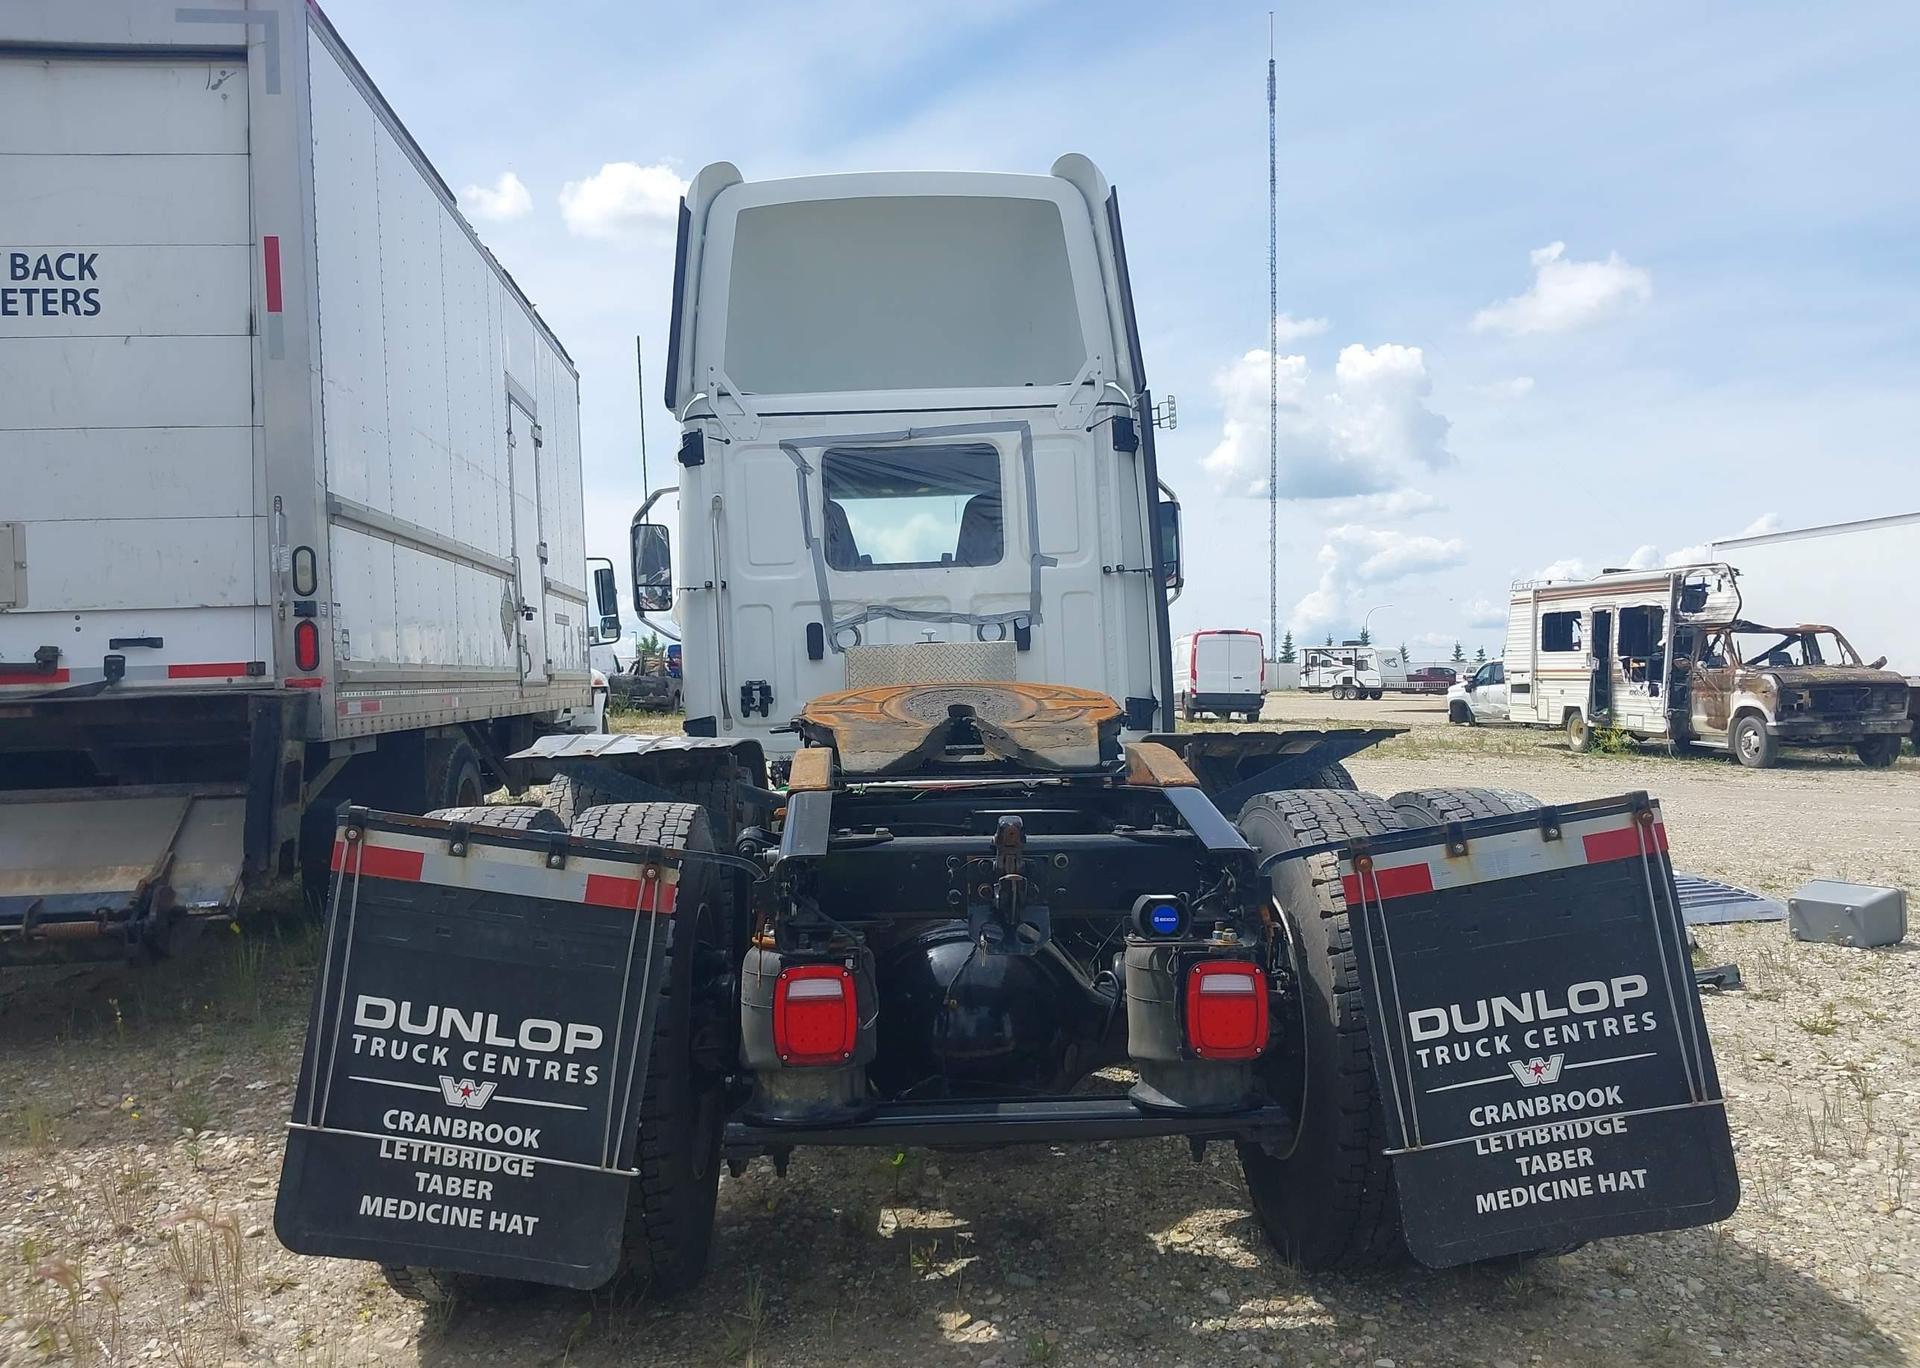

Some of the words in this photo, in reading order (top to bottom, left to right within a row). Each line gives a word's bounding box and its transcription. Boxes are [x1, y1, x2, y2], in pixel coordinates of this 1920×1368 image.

[10, 252, 99, 281] BACK
[1, 287, 101, 316] ETERS
[354, 994, 603, 1054] DUNLOP
[1408, 974, 1648, 1042] DUNLOP
[351, 1033, 450, 1067] TRUCK
[462, 1050, 600, 1086] CENTRES
[1416, 1034, 1512, 1068] TRUCK
[1523, 1011, 1657, 1049] CENTRES
[1469, 1085, 1624, 1127] CRANBROOK
[382, 1109, 542, 1149] CRANBROOK
[1475, 1115, 1628, 1156] LETHBRIDGE
[379, 1137, 536, 1178] LETHBRIDGE
[1515, 1147, 1594, 1177] TABER
[415, 1171, 494, 1201] TABER
[1475, 1176, 1594, 1214] MEDICINE
[1598, 1168, 1648, 1194] HAT
[359, 1194, 483, 1229] MEDICINE
[488, 1211, 540, 1236] HAT
